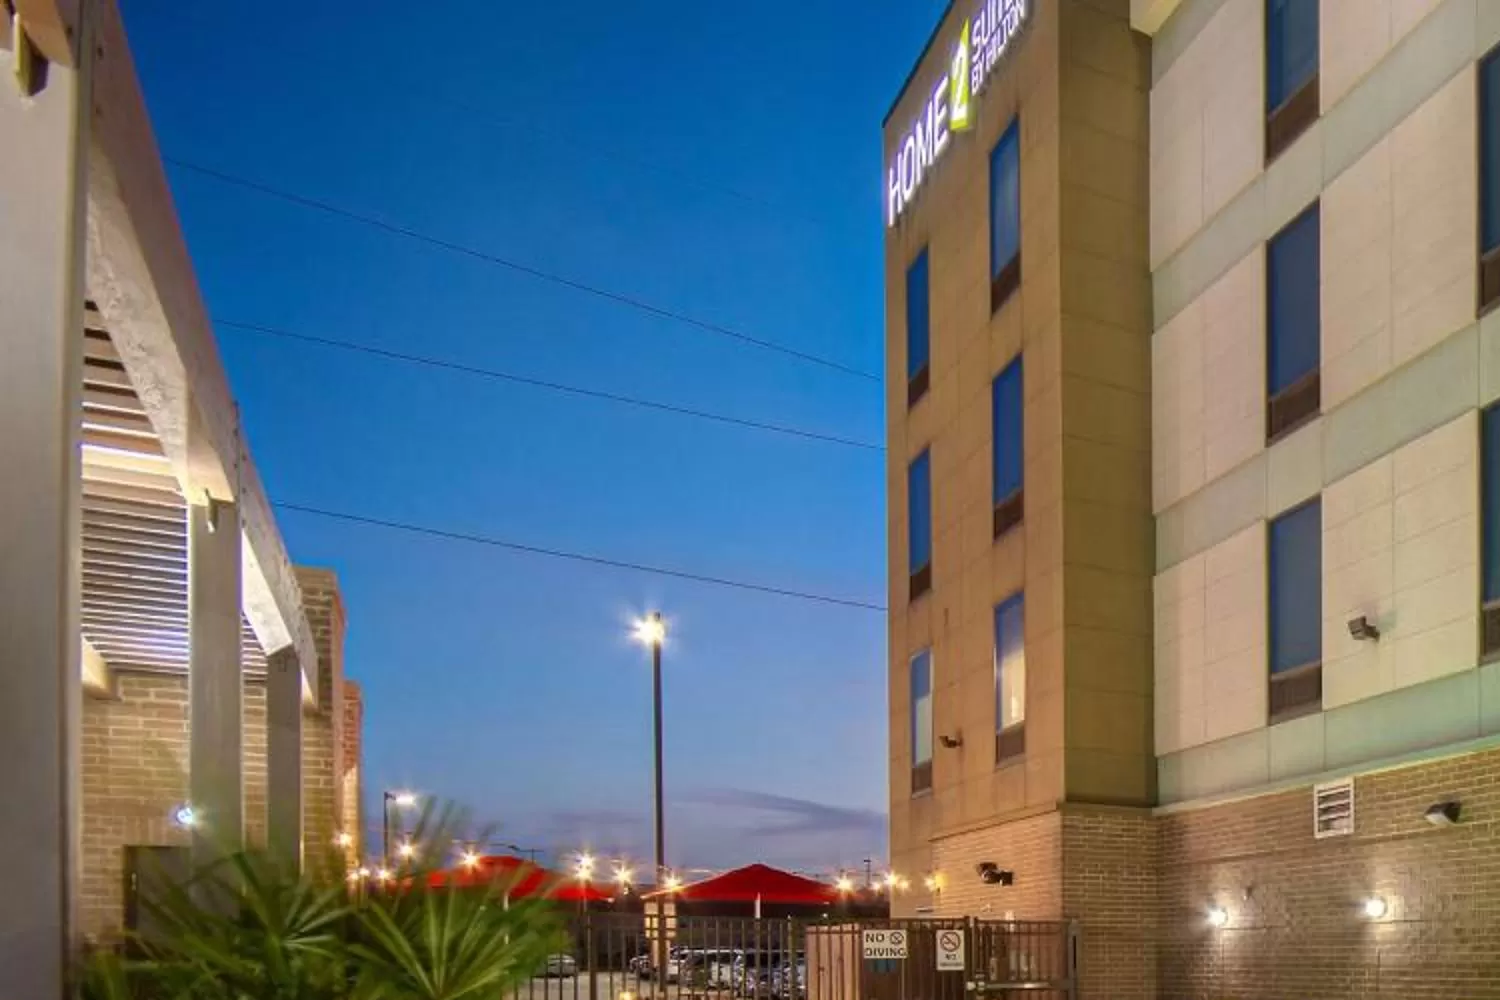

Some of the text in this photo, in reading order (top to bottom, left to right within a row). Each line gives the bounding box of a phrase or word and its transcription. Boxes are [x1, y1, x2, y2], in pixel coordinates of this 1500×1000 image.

[971, 51, 985, 96] BY
[888, 74, 949, 228] HOME
[972, 0, 1013, 62] SUI
[865, 933, 885, 943] NO
[865, 947, 906, 957] DIVING
